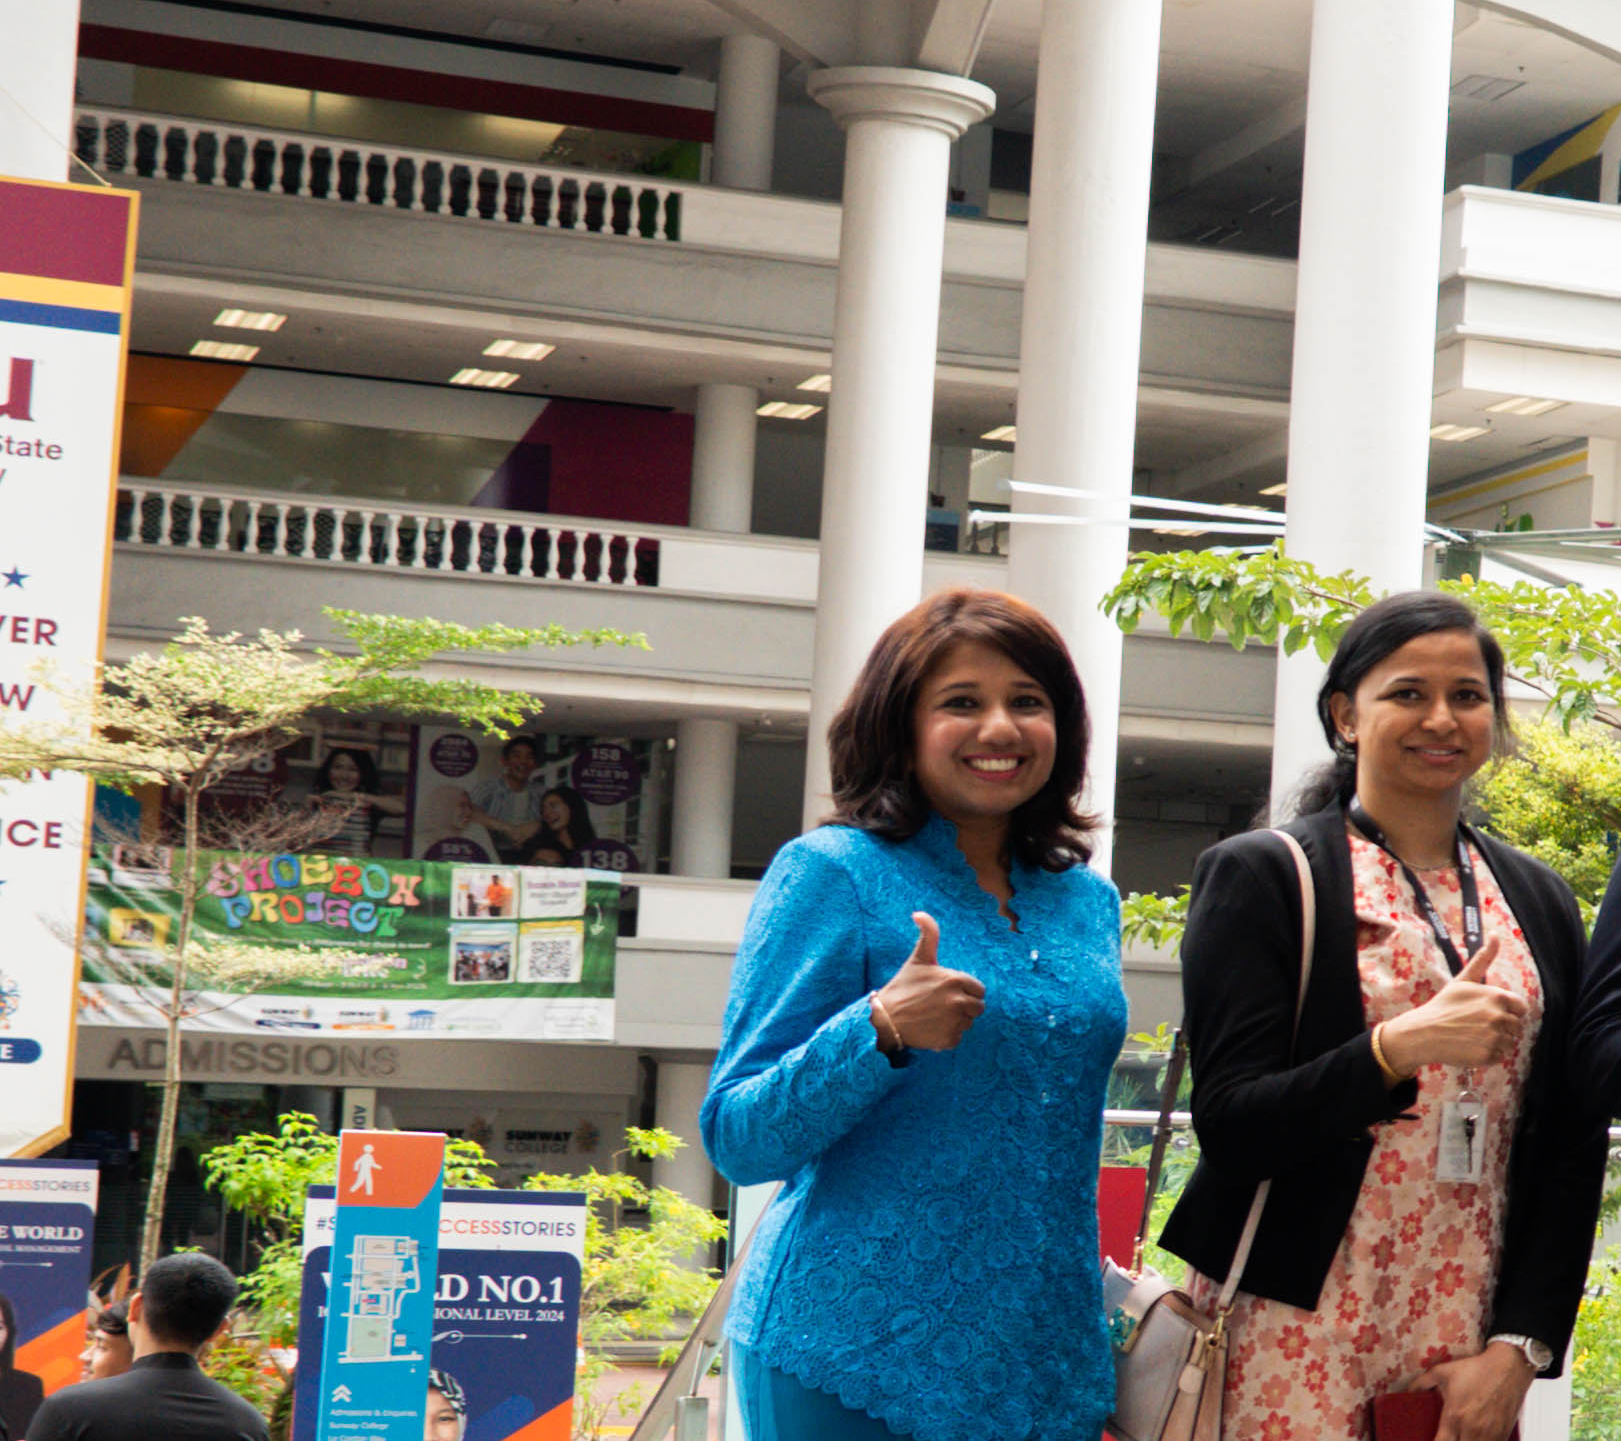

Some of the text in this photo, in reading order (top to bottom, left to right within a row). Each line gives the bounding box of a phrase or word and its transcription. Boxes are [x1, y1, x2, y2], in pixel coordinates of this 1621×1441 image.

[0, 435, 63, 460] tate
[580, 850, 630, 872] 138
[206, 854, 423, 906] SHOEBOX
[220, 892, 404, 937] PROJECT
[108, 1037, 398, 1077] ADMISSIONS
[505, 1130, 573, 1142] SUNWAY
[12, 1225, 84, 1241] WORLD
[477, 1275, 565, 1304] NO.1
[485, 1309, 533, 1321] LEVEL
[535, 1310, 565, 1322] 2024
